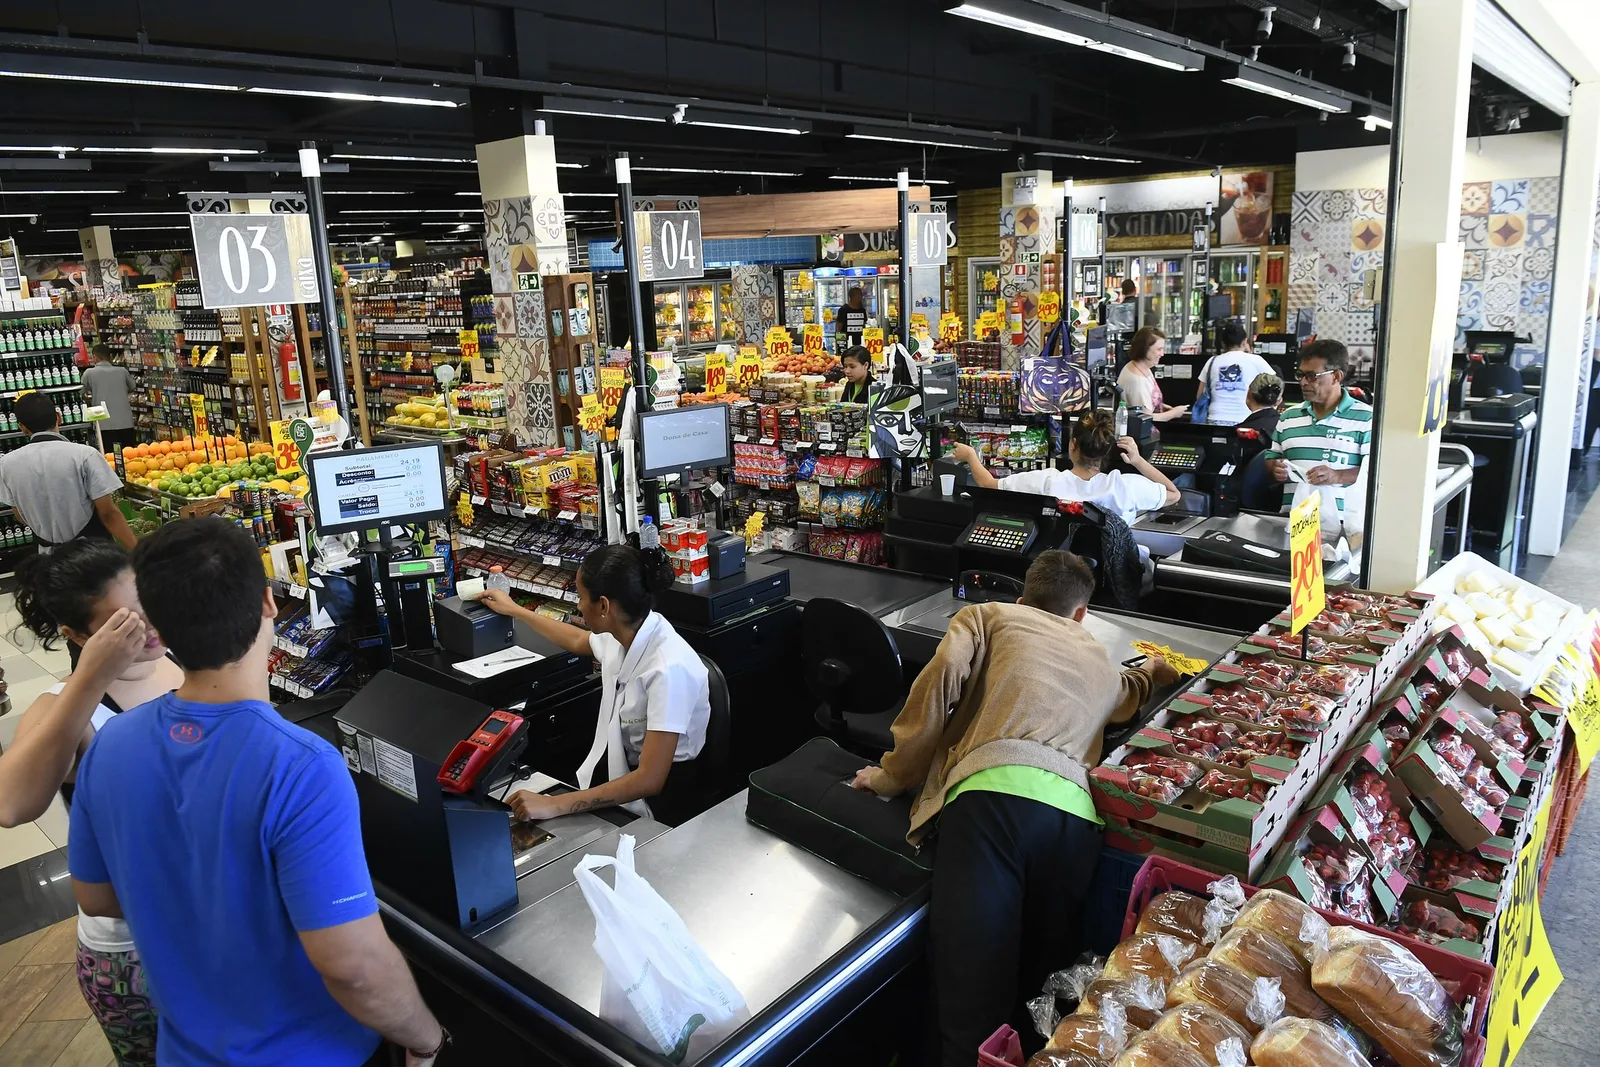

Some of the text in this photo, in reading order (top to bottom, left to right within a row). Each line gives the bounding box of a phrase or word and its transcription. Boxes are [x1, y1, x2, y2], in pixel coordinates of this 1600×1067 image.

[661, 220, 696, 270] 04
[924, 219, 941, 259] 05
[1080, 219, 1095, 252] 06
[219, 226, 277, 294] 03
[293, 257, 317, 299] caixa
[640, 245, 655, 279] caixa
[341, 470, 374, 478] Desconto:
[356, 453, 399, 462] PAGAMENTO
